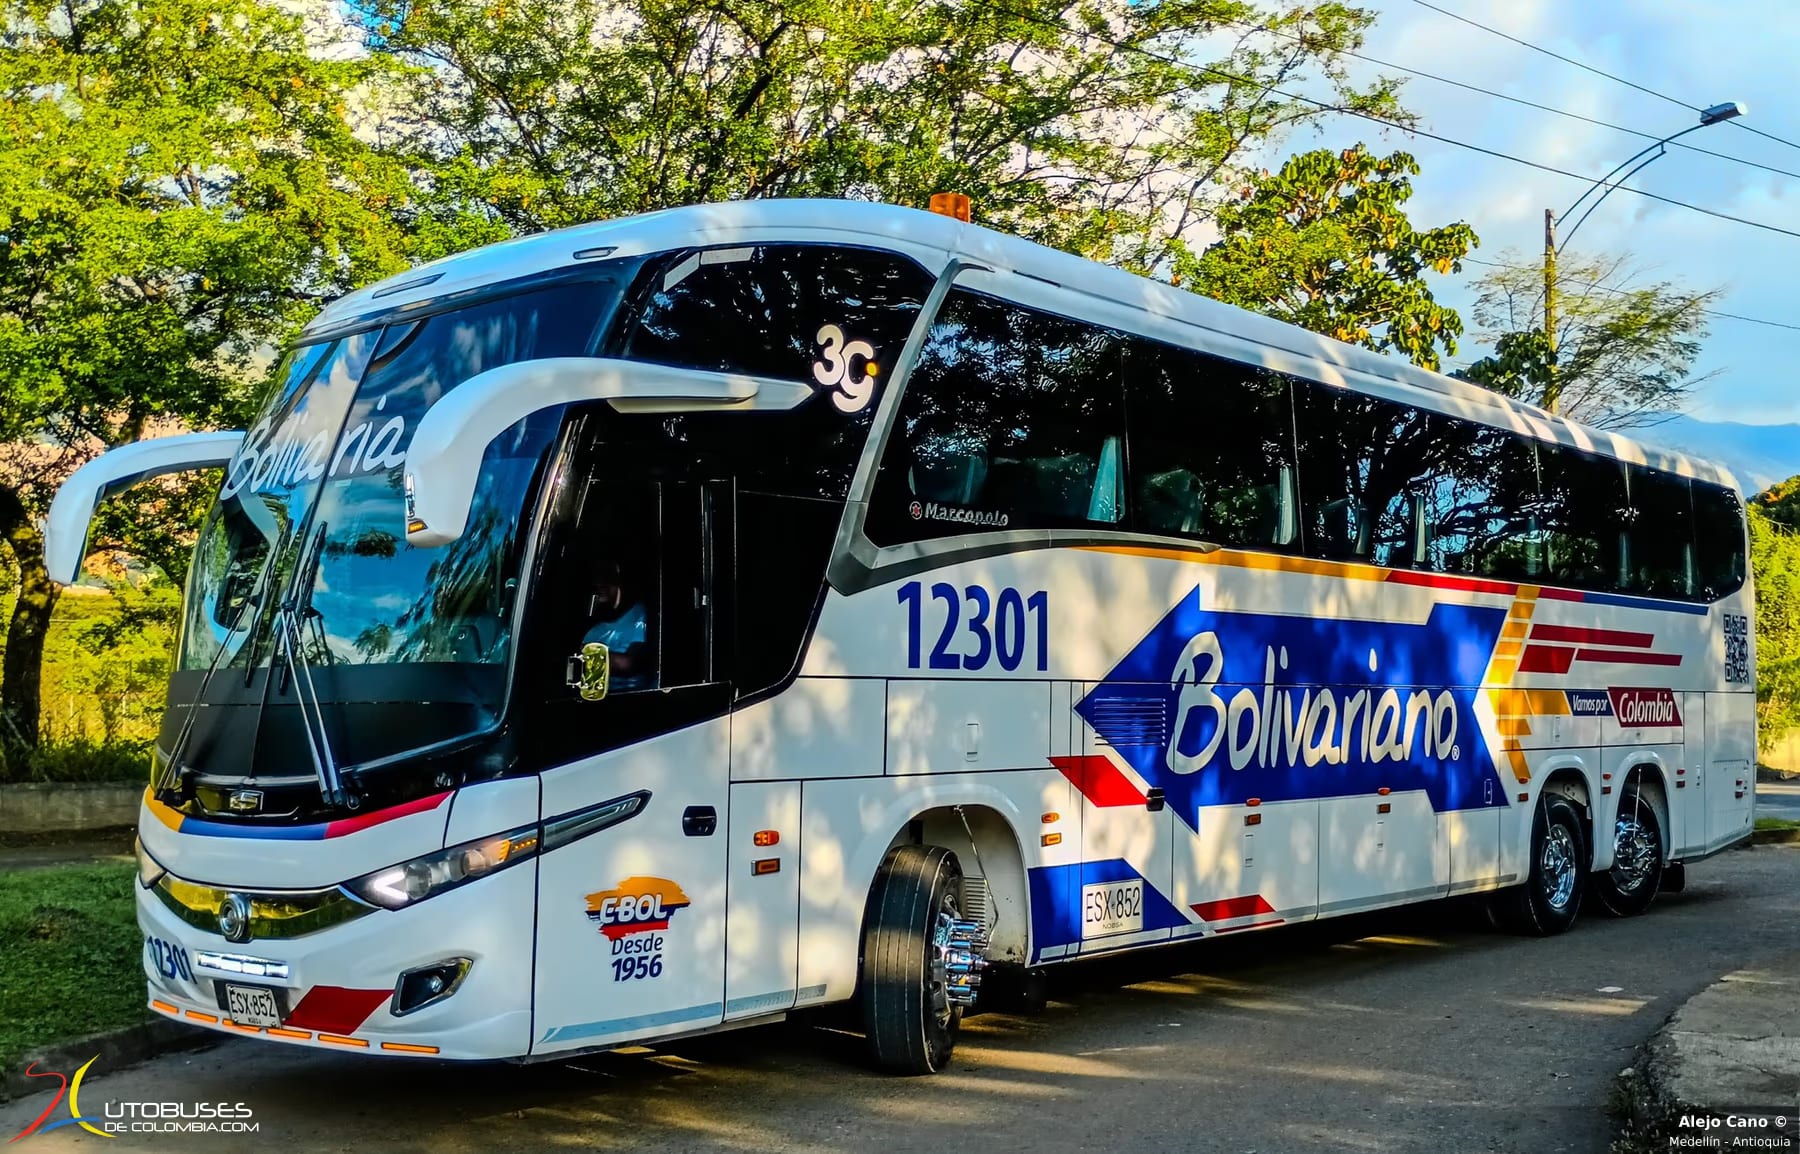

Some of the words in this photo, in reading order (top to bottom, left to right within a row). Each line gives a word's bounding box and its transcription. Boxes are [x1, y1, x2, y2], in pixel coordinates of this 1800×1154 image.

[925, 502, 1009, 526] Marcopolo
[897, 581, 1048, 671] 12301
[1573, 695, 1595, 712] Vamos
[1595, 698, 1608, 716] por
[1619, 691, 1673, 723] Colombia
[611, 933, 663, 955] Desde
[147, 935, 198, 984] 12301
[611, 954, 663, 982] 1956
